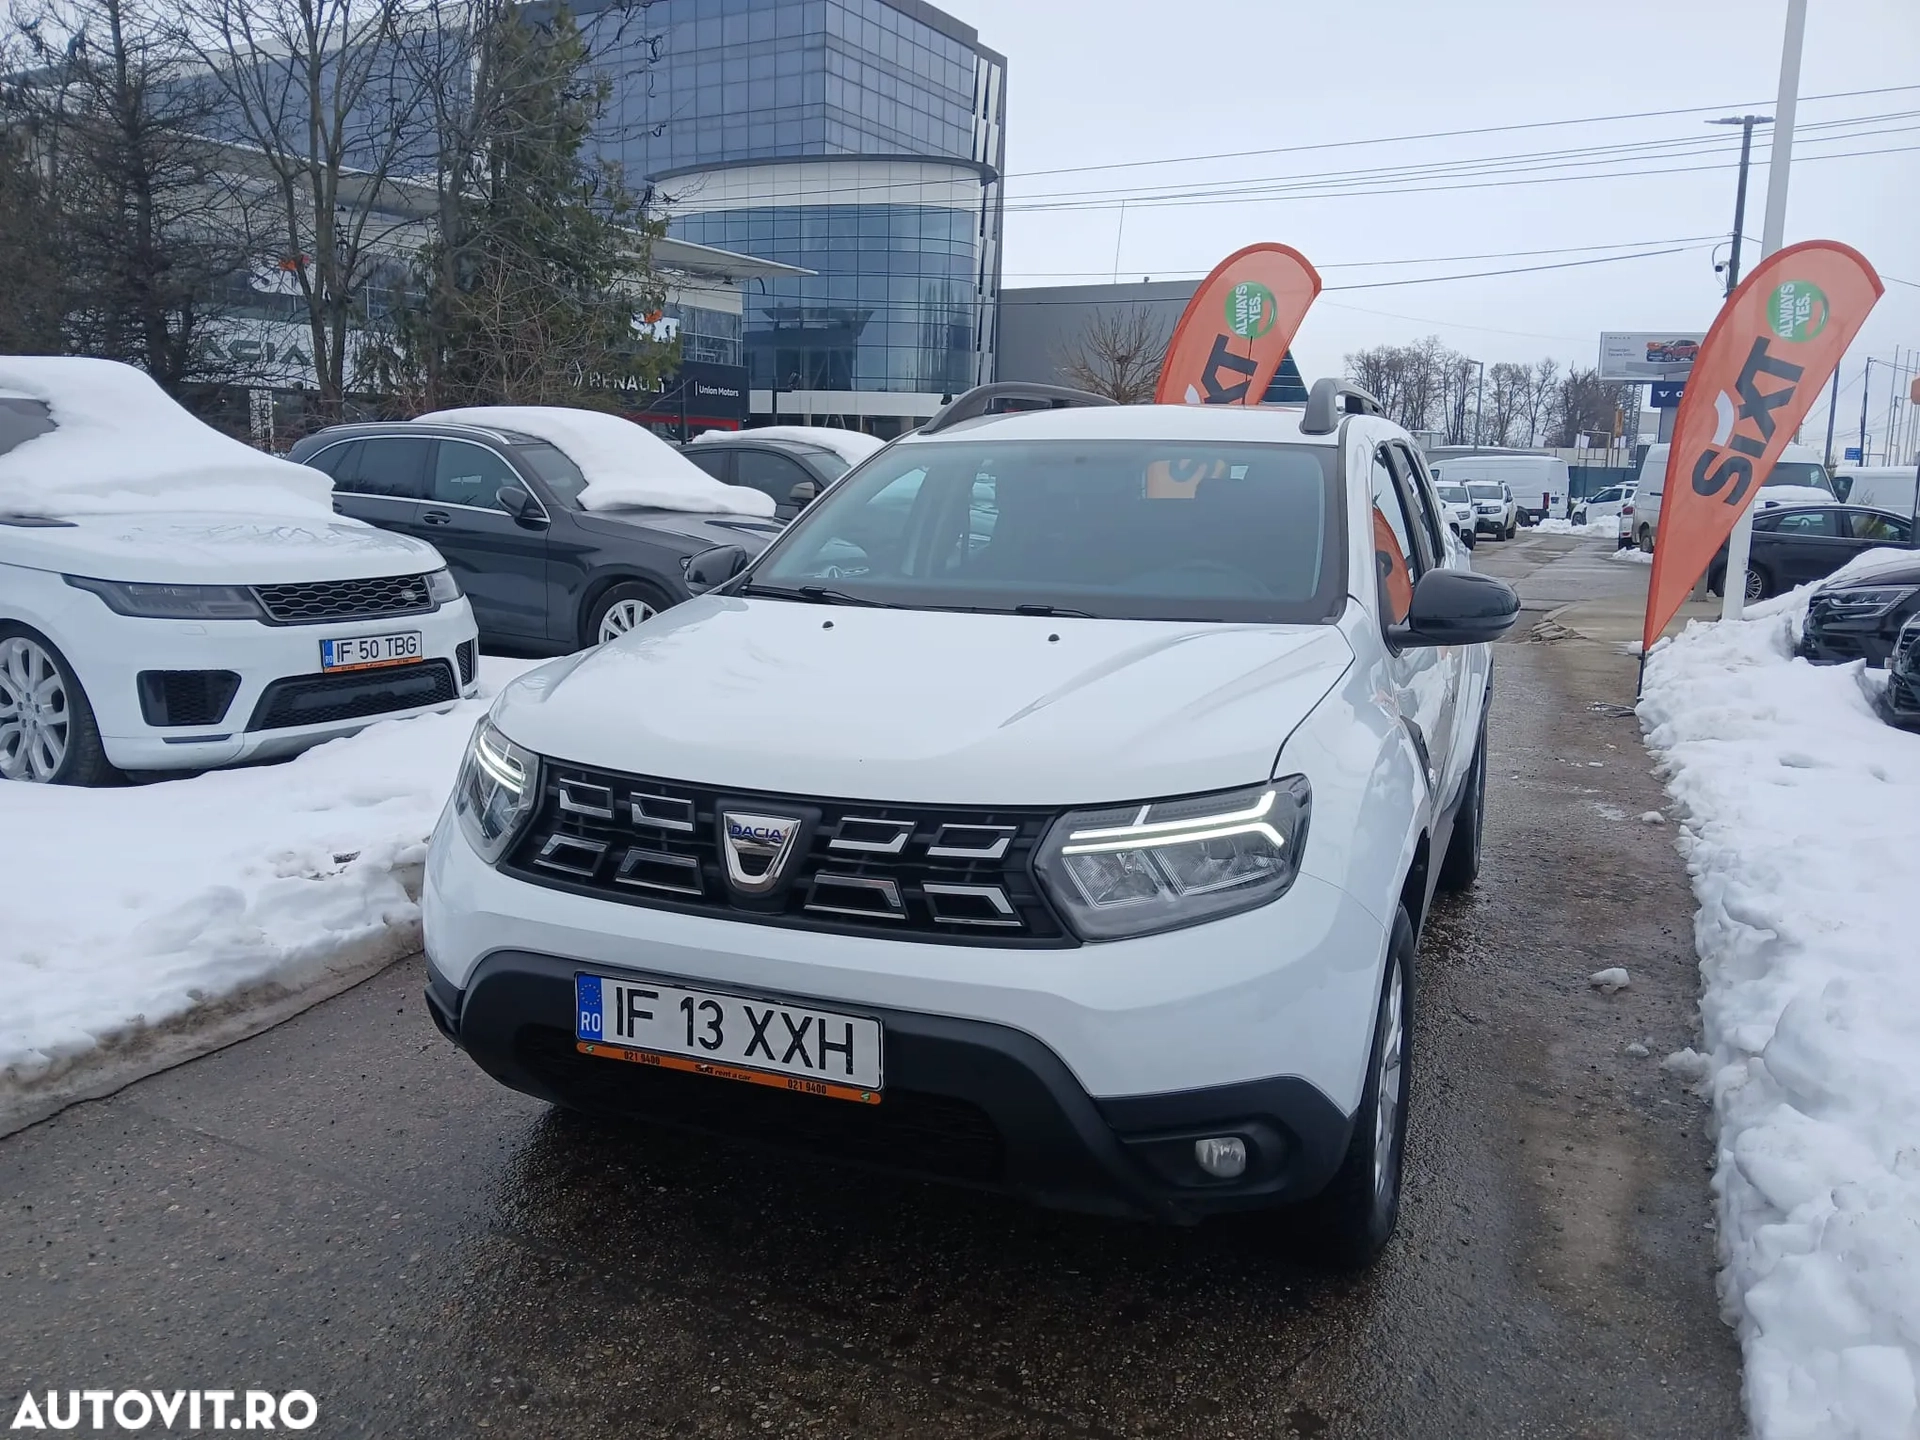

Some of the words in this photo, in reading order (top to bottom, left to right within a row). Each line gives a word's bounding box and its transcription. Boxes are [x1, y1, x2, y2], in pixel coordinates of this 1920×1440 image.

[1235, 284, 1248, 335] ALWAYS
[1249, 293, 1261, 324] YES.
[1780, 284, 1794, 337] ALWAYS
[1796, 293, 1811, 325] YES.
[699, 385, 717, 394] Union
[718, 387, 739, 397] Motors
[1692, 336, 1805, 506] SIXT
[336, 642, 352, 663] IF
[359, 640, 379, 660] 50
[385, 636, 417, 657] TBG
[731, 823, 782, 839] DACIA
[581, 1011, 600, 1032] RO
[615, 986, 659, 1038] IF
[680, 997, 724, 1050] 13
[743, 1005, 853, 1075] XXH
[624, 1051, 639, 1062] 021
[641, 1053, 661, 1065] 9400
[715, 1069, 731, 1077] rent
[787, 1079, 803, 1090] 021
[805, 1082, 827, 1095] 9400
